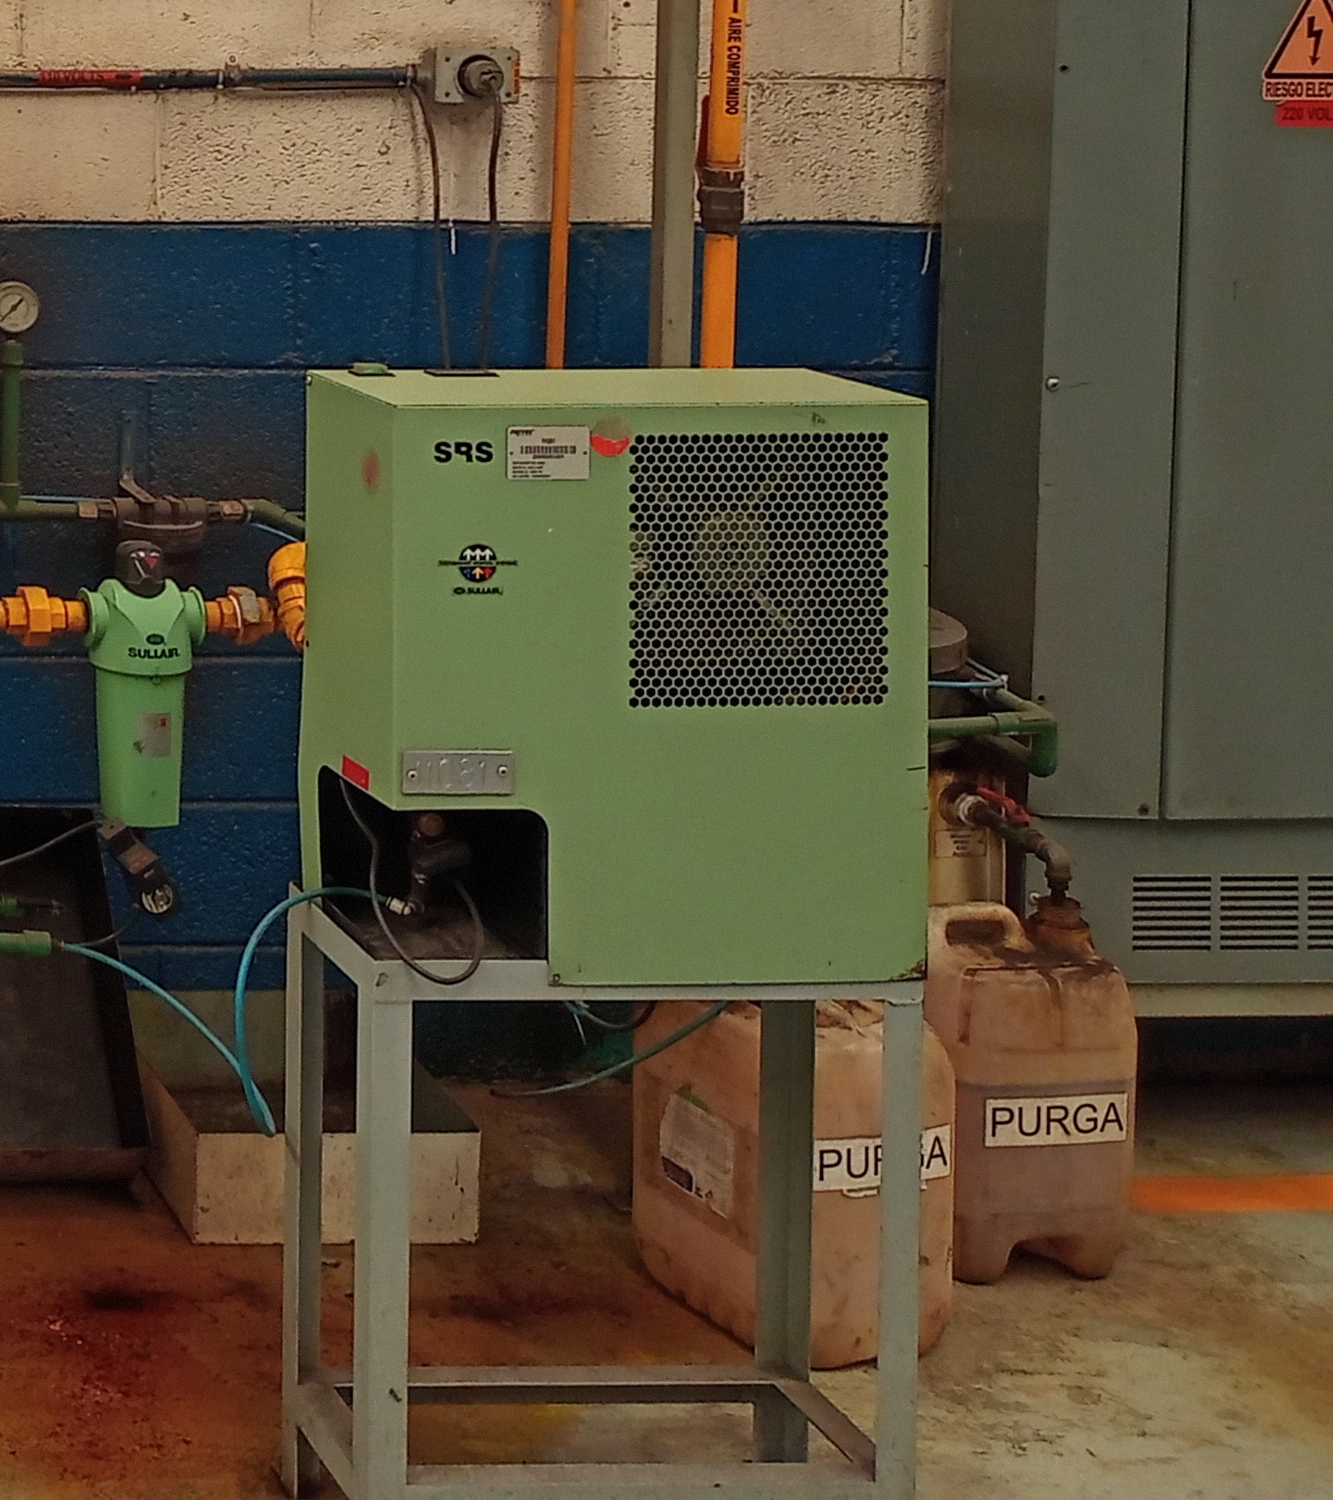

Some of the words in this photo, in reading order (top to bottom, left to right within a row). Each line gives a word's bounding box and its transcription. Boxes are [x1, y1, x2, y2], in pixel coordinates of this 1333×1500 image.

[727, 16, 743, 43] AIRE
[724, 45, 742, 116] COMPRIMIDO
[1265, 82, 1304, 98] RIESGO
[1282, 106, 1304, 121] 220
[127, 647, 180, 660] SULLAIR
[990, 1101, 1124, 1138] PURGA
[818, 1136, 948, 1182] PUA
